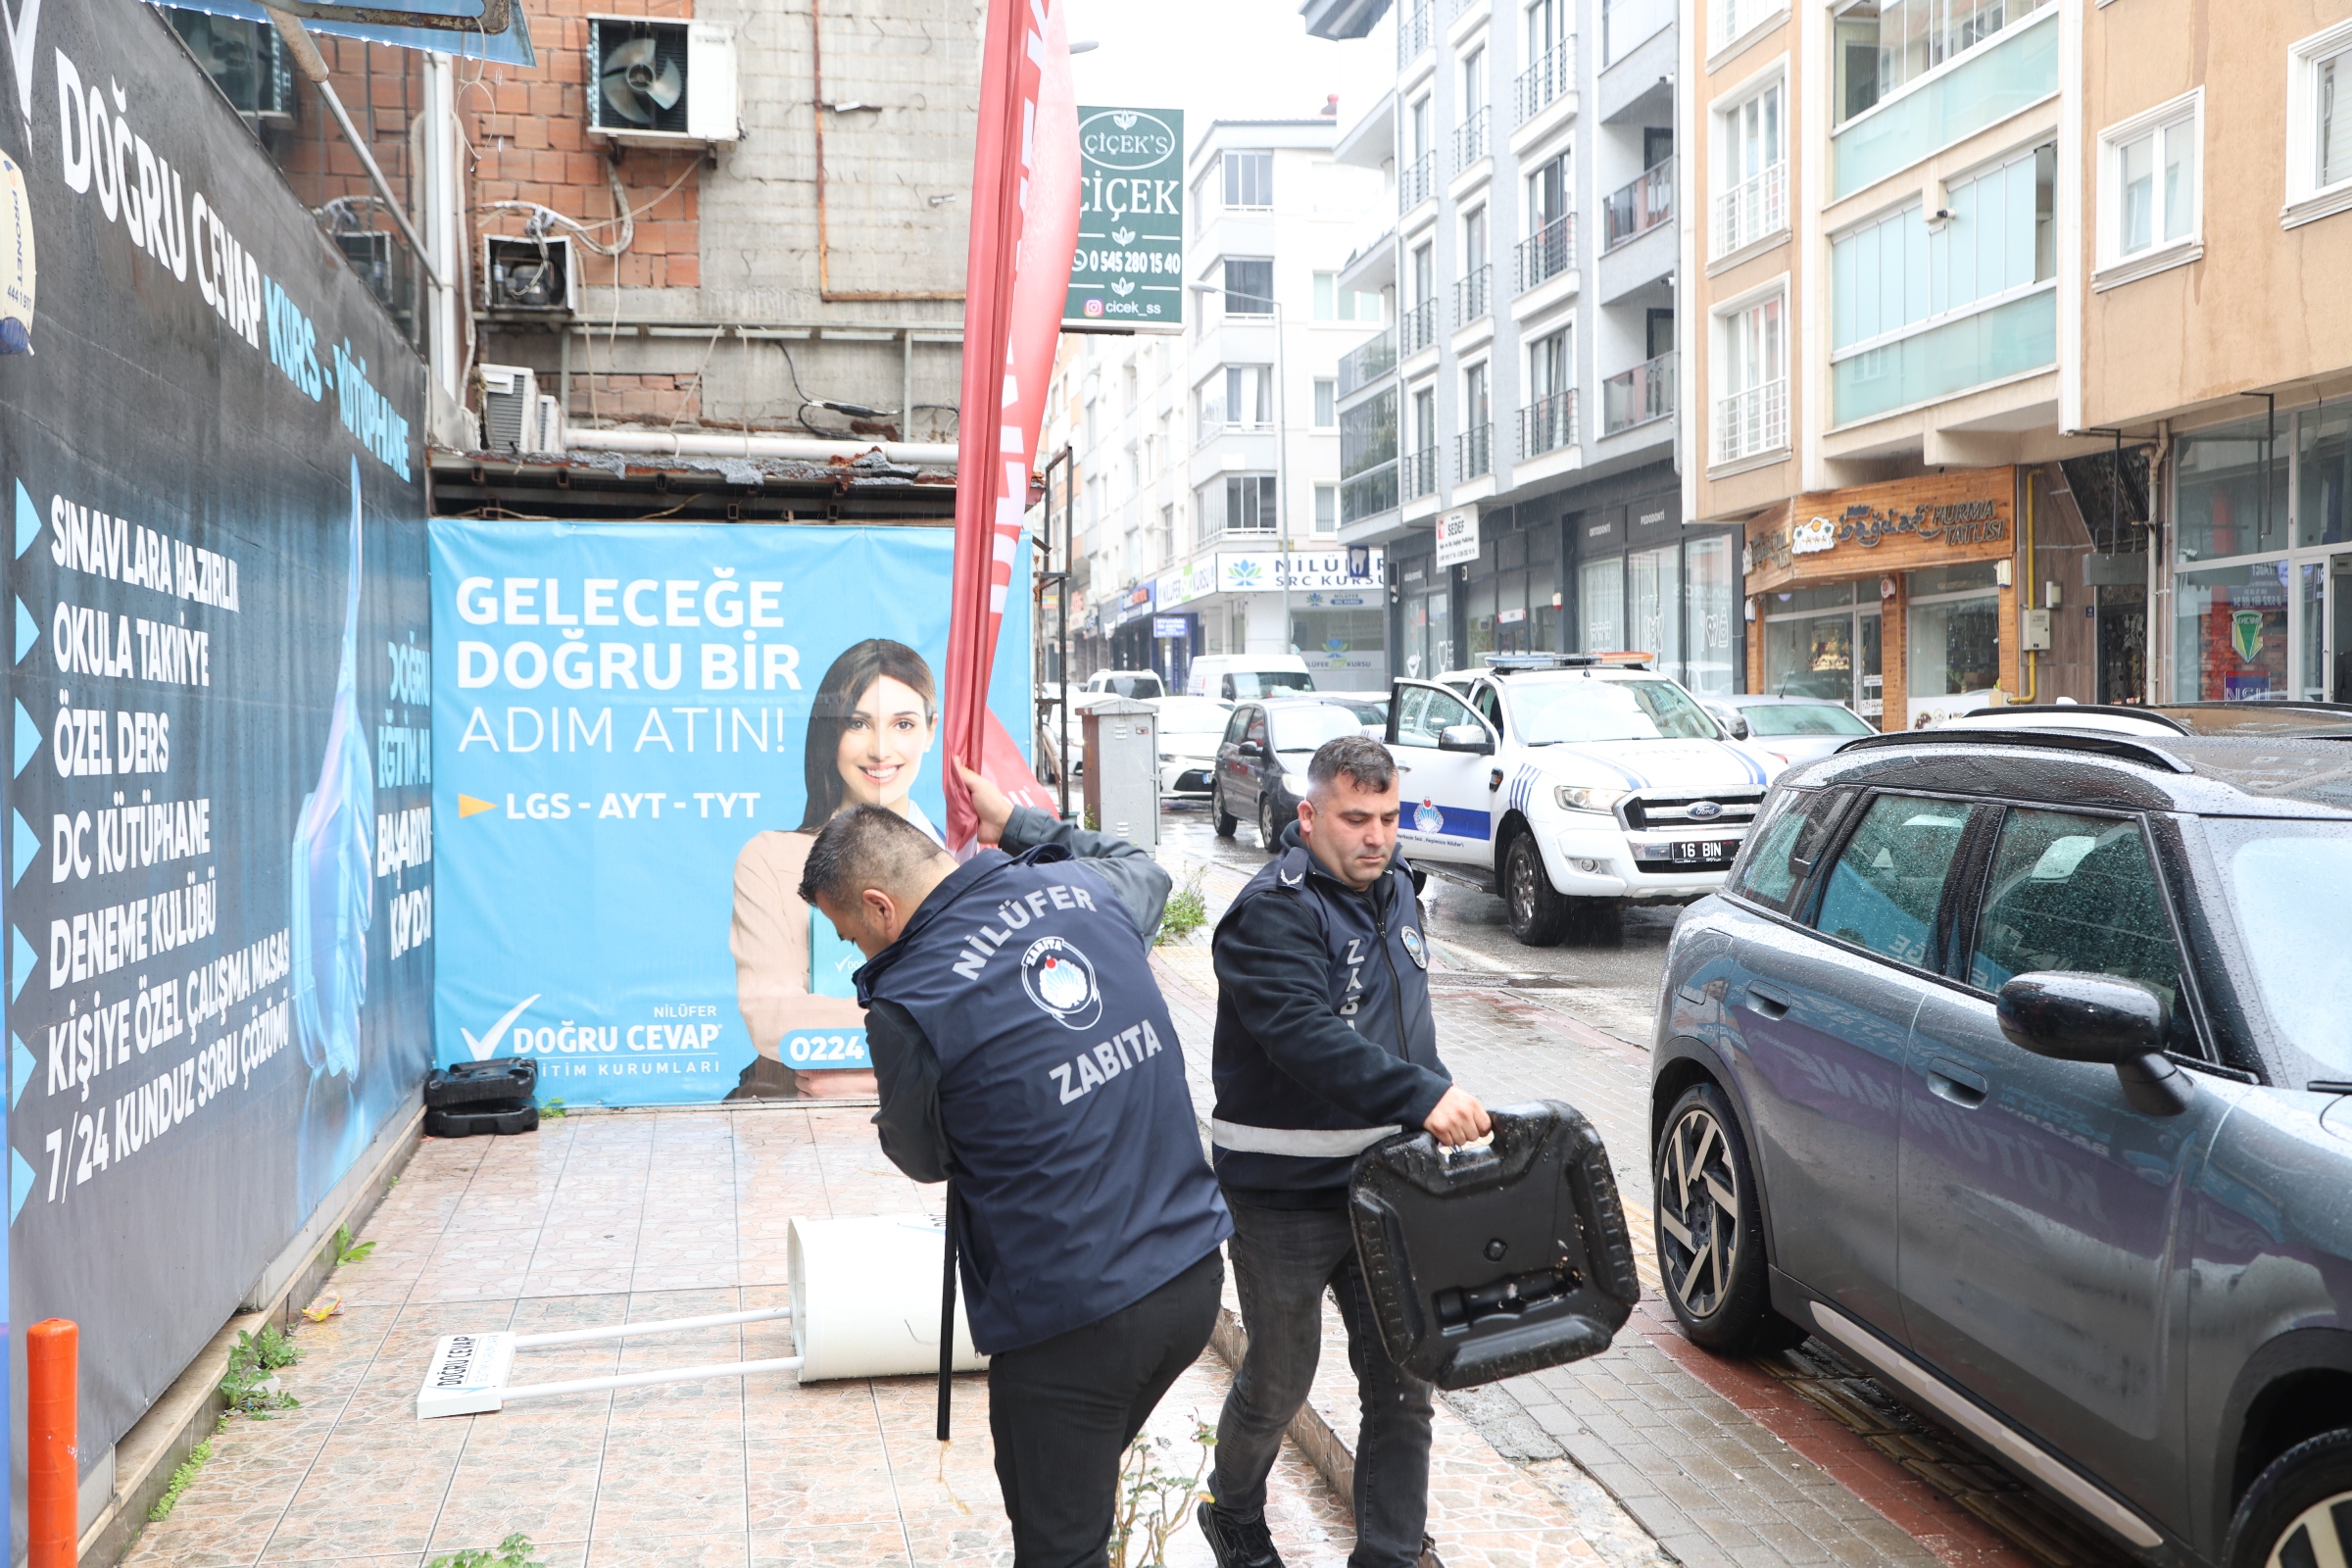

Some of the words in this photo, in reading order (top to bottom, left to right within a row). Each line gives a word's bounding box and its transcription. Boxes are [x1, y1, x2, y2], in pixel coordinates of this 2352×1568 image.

[12, 189, 24, 287] PRONET
[56, 46, 187, 282] DOĞRU
[192, 191, 262, 350] CEVAP
[265, 273, 321, 403] KURS
[1090, 252, 1099, 271] 0
[1101, 252, 1123, 272] 545
[1124, 252, 1148, 273] 280
[1150, 252, 1163, 273] 15
[1164, 252, 1181, 274] 40
[1105, 300, 1161, 317] cicek_ss
[1447, 519, 1465, 536] SEDEF
[1933, 500, 1995, 525] HURMA
[51, 494, 172, 595] SINAVLARA
[1275, 555, 1384, 572] NİLÜR
[1275, 576, 1312, 587] SRC
[456, 565, 784, 628] GELECEĞE
[52, 600, 134, 679] OKULA
[136, 611, 210, 687] TAKVİYE
[458, 628, 683, 691] DOĞRU
[700, 629, 803, 691] BİR
[52, 689, 113, 779] ÖZEL
[117, 711, 170, 775] DERS
[377, 708, 418, 789] EĞTİM
[458, 707, 612, 754] ADIM
[633, 707, 785, 754] ATIN!
[506, 792, 571, 820] LGS
[599, 792, 670, 819] AYT
[693, 792, 761, 818] TYT
[1695, 806, 1716, 815] Ford
[52, 810, 92, 884] DC
[97, 789, 211, 875] KÜTÜPHANE
[1681, 843, 1695, 858] 16
[1702, 843, 1722, 858] BIN
[49, 898, 148, 990] DENEME
[151, 865, 217, 956] KULÜBÜ
[952, 884, 1098, 981] NİLÜFER
[1025, 939, 1062, 966] ZABITA
[47, 991, 130, 1102] KİŞİYE
[134, 974, 183, 1054] ÖZEL
[186, 949, 250, 1045] ÇALIŞMA
[654, 1003, 717, 1019] NİLÜFER
[513, 1019, 617, 1055] DOĞRU
[626, 1024, 719, 1053] CEVAP
[789, 1035, 865, 1062] 0224
[542, 1059, 587, 1077] İTİM
[598, 1059, 720, 1077] KURUMLARI
[1049, 1018, 1163, 1105] ZABITA
[46, 1106, 109, 1204] 7/24
[115, 1057, 196, 1164] KUNDUZ
[197, 1031, 238, 1107] SORU
[241, 986, 290, 1090] ÇÖZÜMÜ
[447, 1336, 477, 1358] CEVAP
[436, 1360, 469, 1387] DOĞRU
